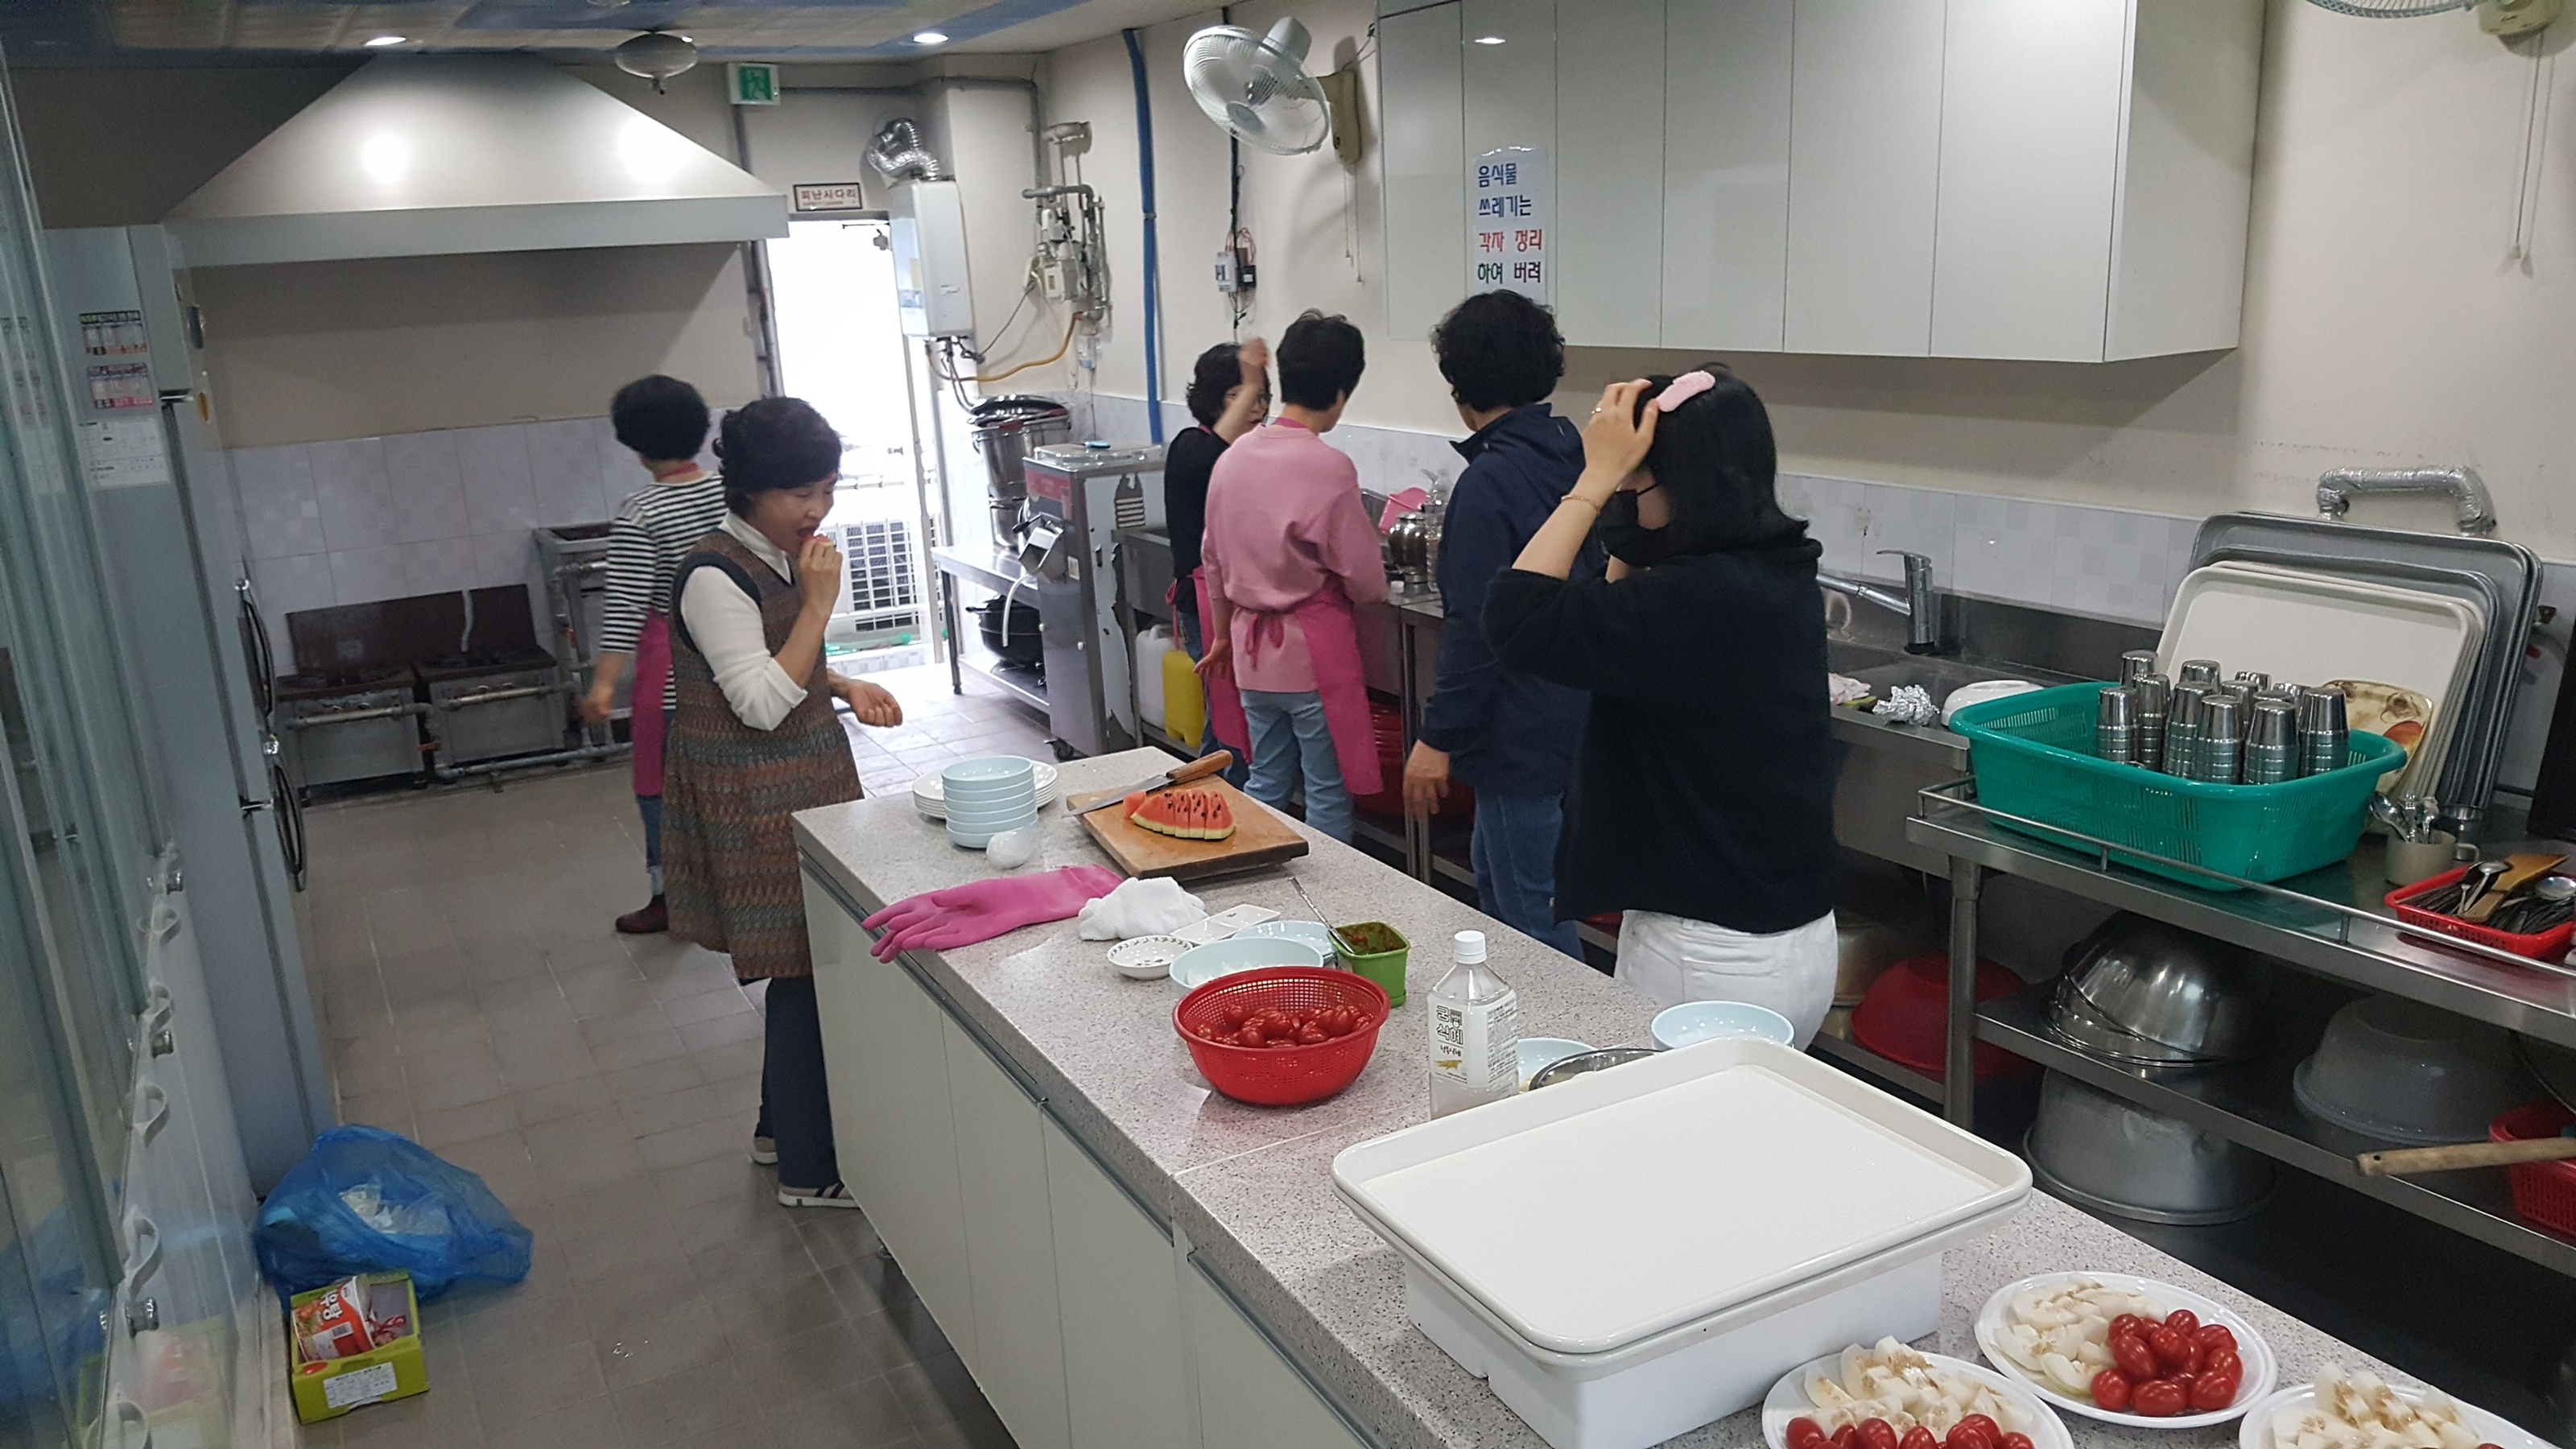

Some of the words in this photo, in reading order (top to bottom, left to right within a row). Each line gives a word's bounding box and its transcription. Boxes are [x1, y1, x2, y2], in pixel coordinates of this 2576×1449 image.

[1478, 163, 1517, 188] 음식물
[800, 188, 857, 200] 피난사다리
[1479, 194, 1531, 218] 쓰레기는
[1478, 231, 1505, 253] 각자
[1515, 229, 1542, 253] 정리
[1477, 262, 1503, 284] 하여
[1513, 261, 1542, 283] 버려
[319, 1289, 344, 1321] 우탕
